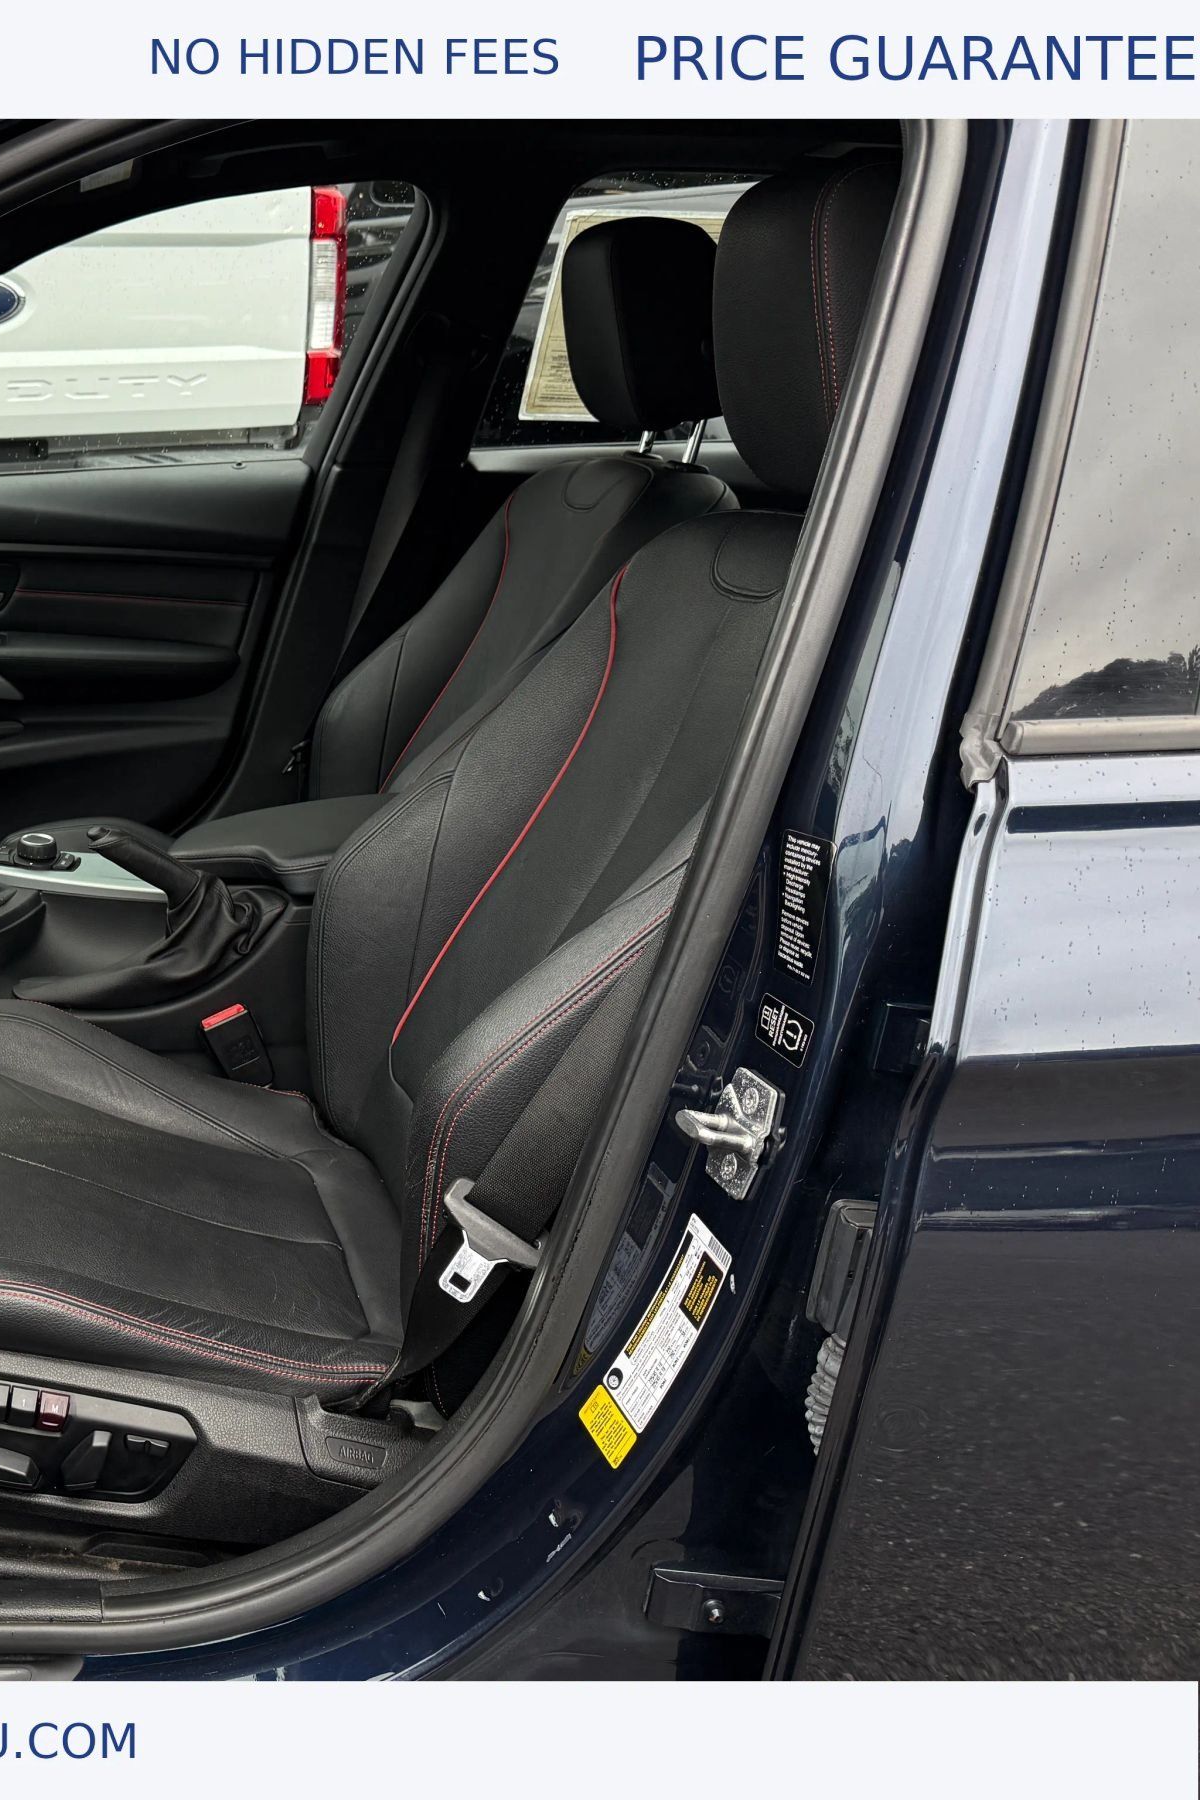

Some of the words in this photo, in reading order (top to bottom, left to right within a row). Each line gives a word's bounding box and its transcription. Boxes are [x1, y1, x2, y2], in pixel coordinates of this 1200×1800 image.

[7, 374, 207, 402] DUTY
[769, 1008, 779, 1038] RESET
[51, 1404, 59, 1413] M
[339, 1446, 374, 1463] AIRBAG
